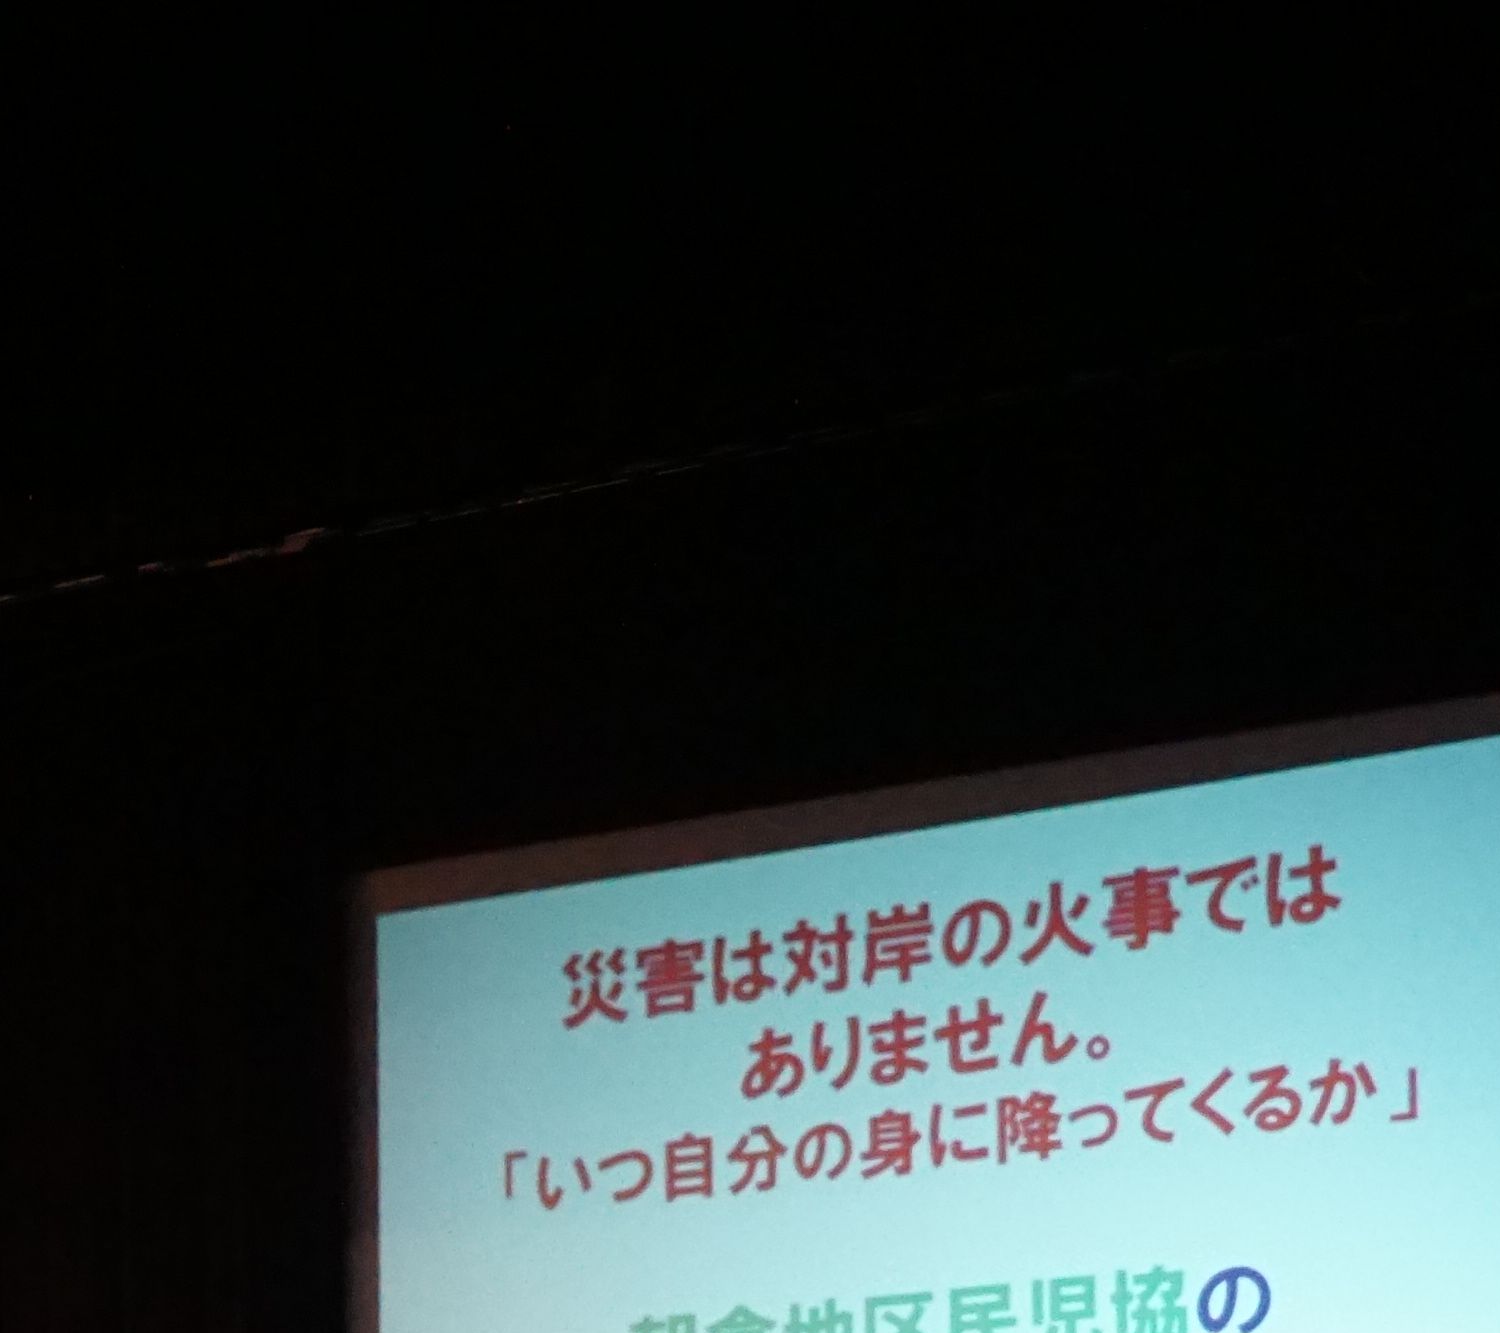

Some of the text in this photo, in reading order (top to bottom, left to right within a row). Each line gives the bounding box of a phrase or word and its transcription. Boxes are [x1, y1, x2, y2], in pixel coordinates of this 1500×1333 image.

[561, 845, 1341, 1031] 災害は対岸の火事では
[741, 990, 1109, 1100] ありません。
[505, 1060, 1417, 1210] 「いつ自分の身に降ってくるか」
